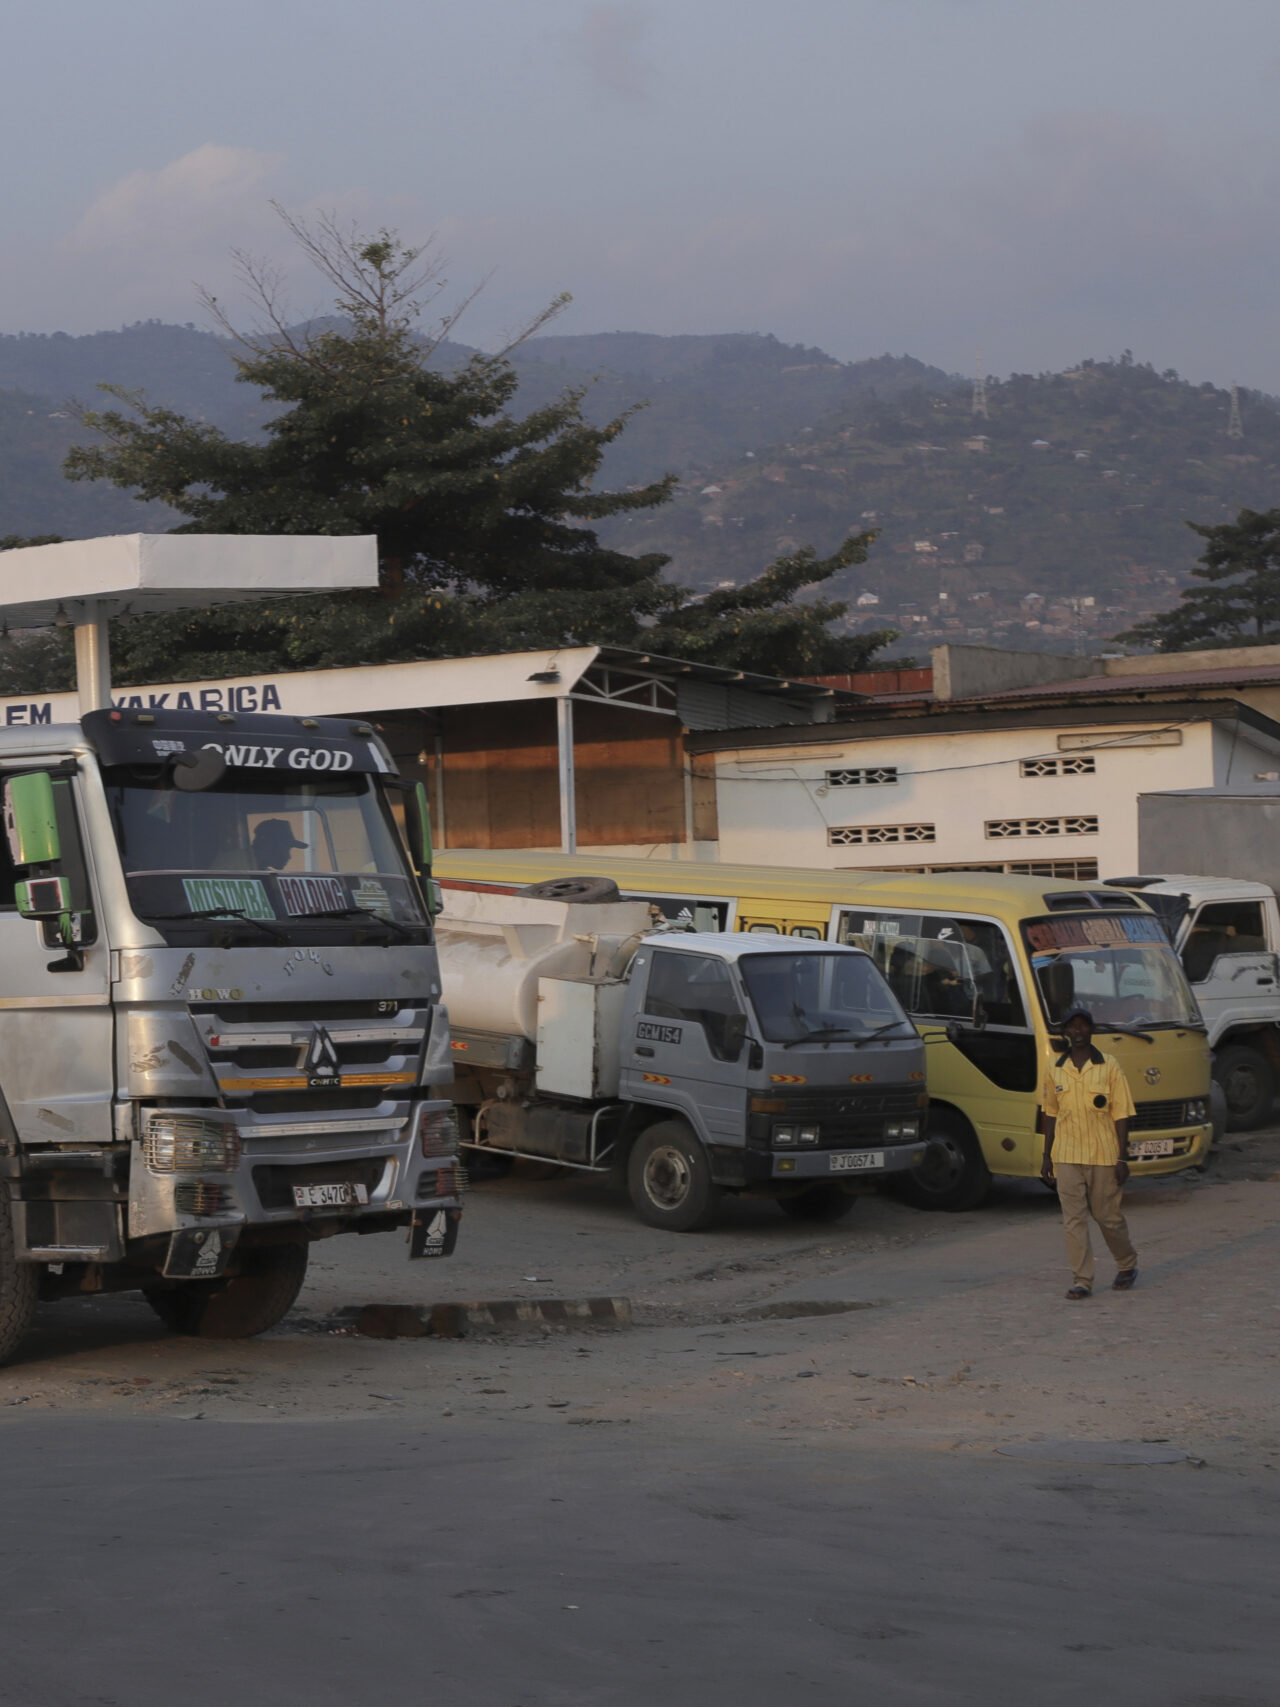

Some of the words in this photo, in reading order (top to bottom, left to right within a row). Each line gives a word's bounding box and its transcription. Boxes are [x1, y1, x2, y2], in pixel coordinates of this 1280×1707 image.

[288, 747, 354, 771] GOD
[276, 876, 348, 917] HOLDING
[188, 987, 244, 1001] HOWO
[377, 1001, 398, 1012] 371
[661, 1027, 681, 1044] 154
[309, 1077, 340, 1086] CNHTC
